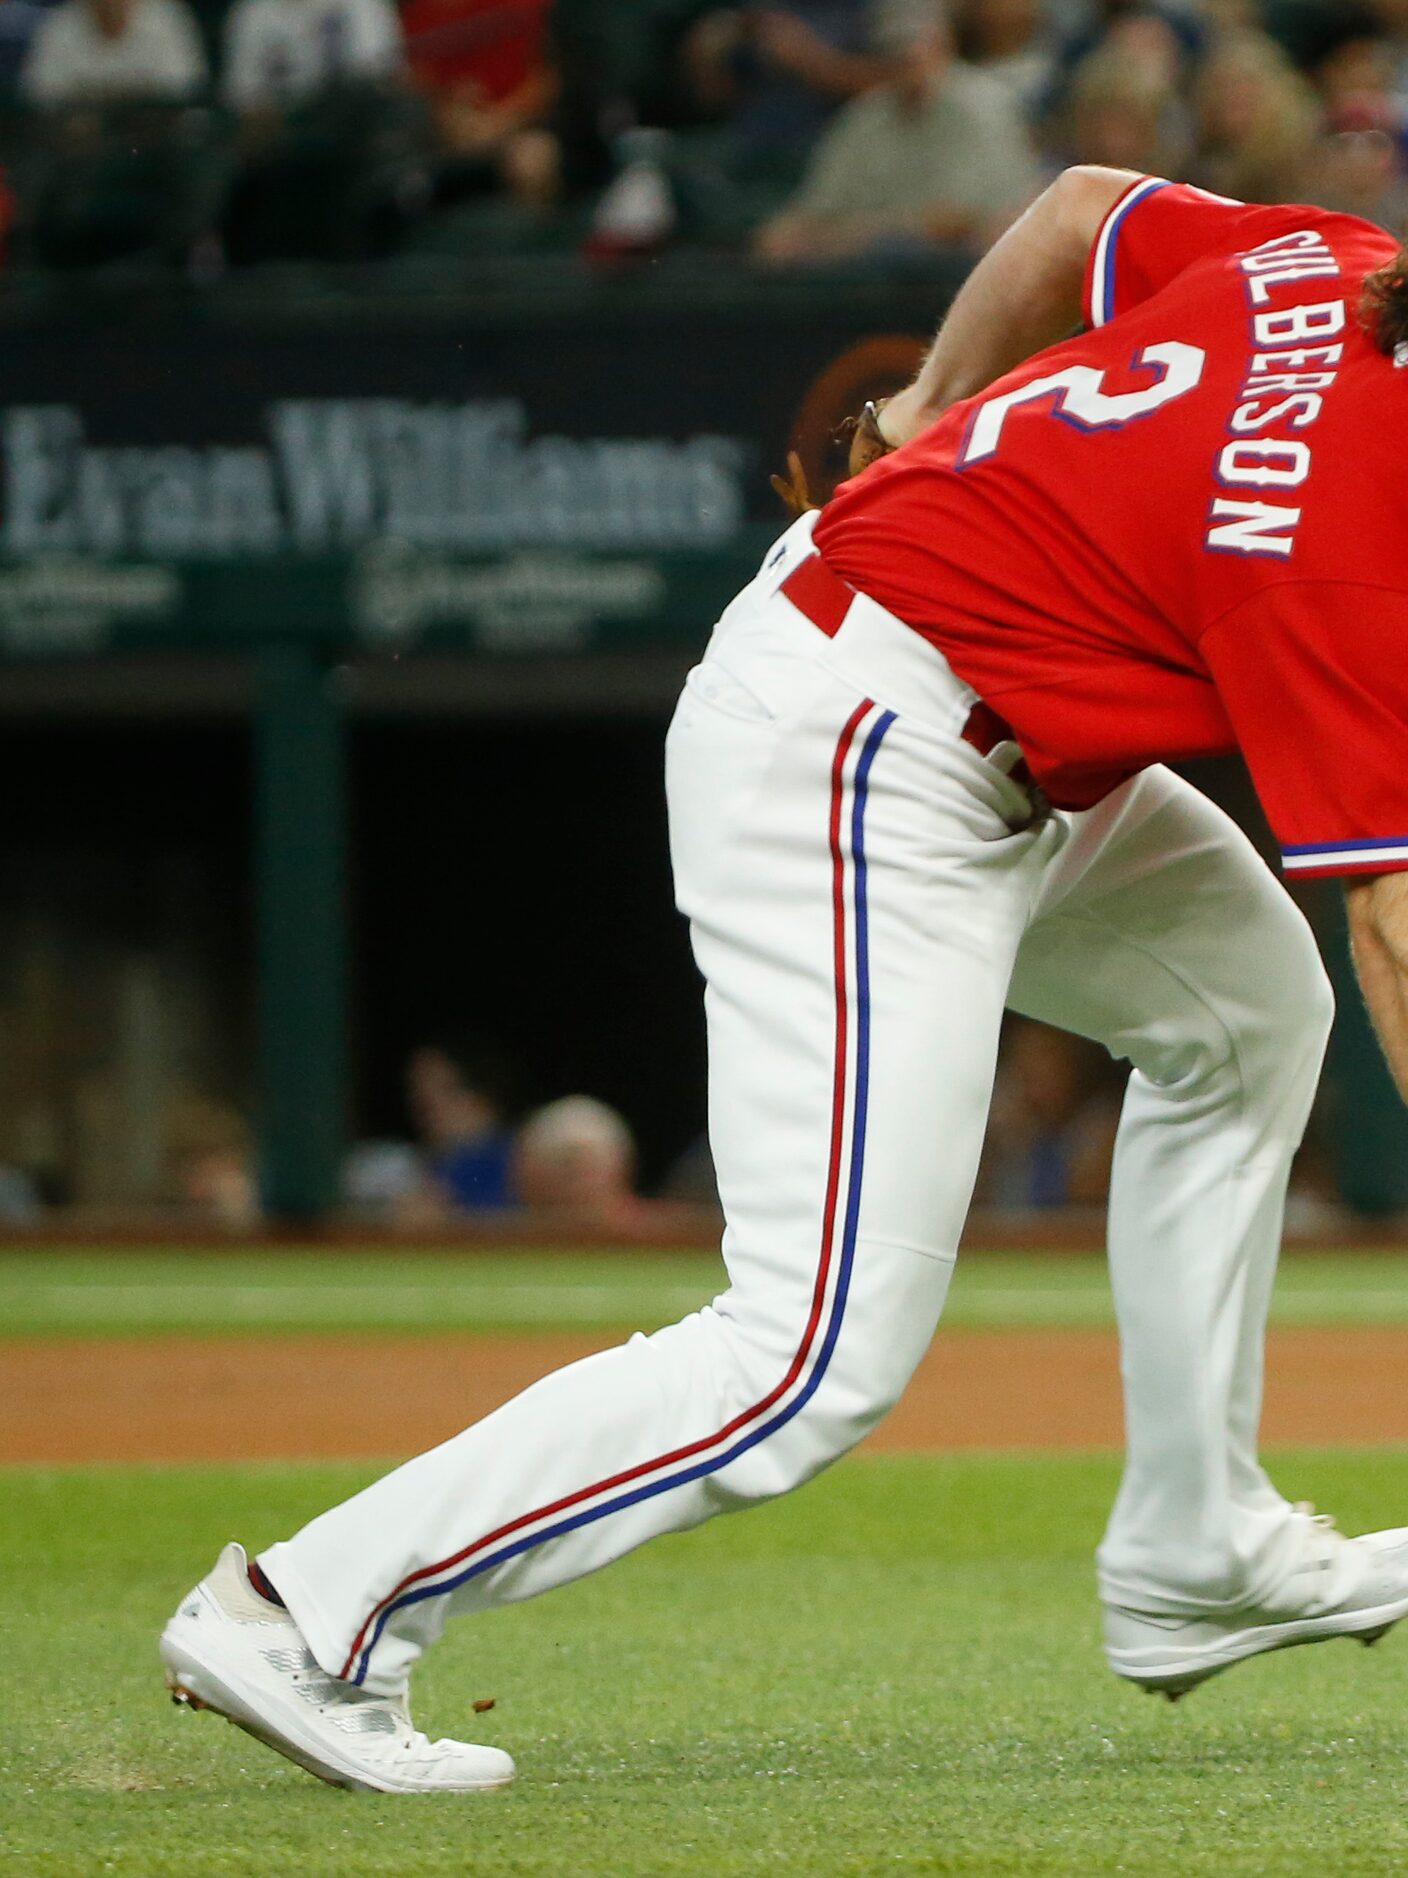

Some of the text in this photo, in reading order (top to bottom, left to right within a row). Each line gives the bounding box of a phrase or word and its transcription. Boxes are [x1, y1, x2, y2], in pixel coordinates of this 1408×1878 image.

[956, 340, 1206, 472] 2
[1204, 229, 1346, 558] CULBERSON
[5, 402, 280, 552] Evan
